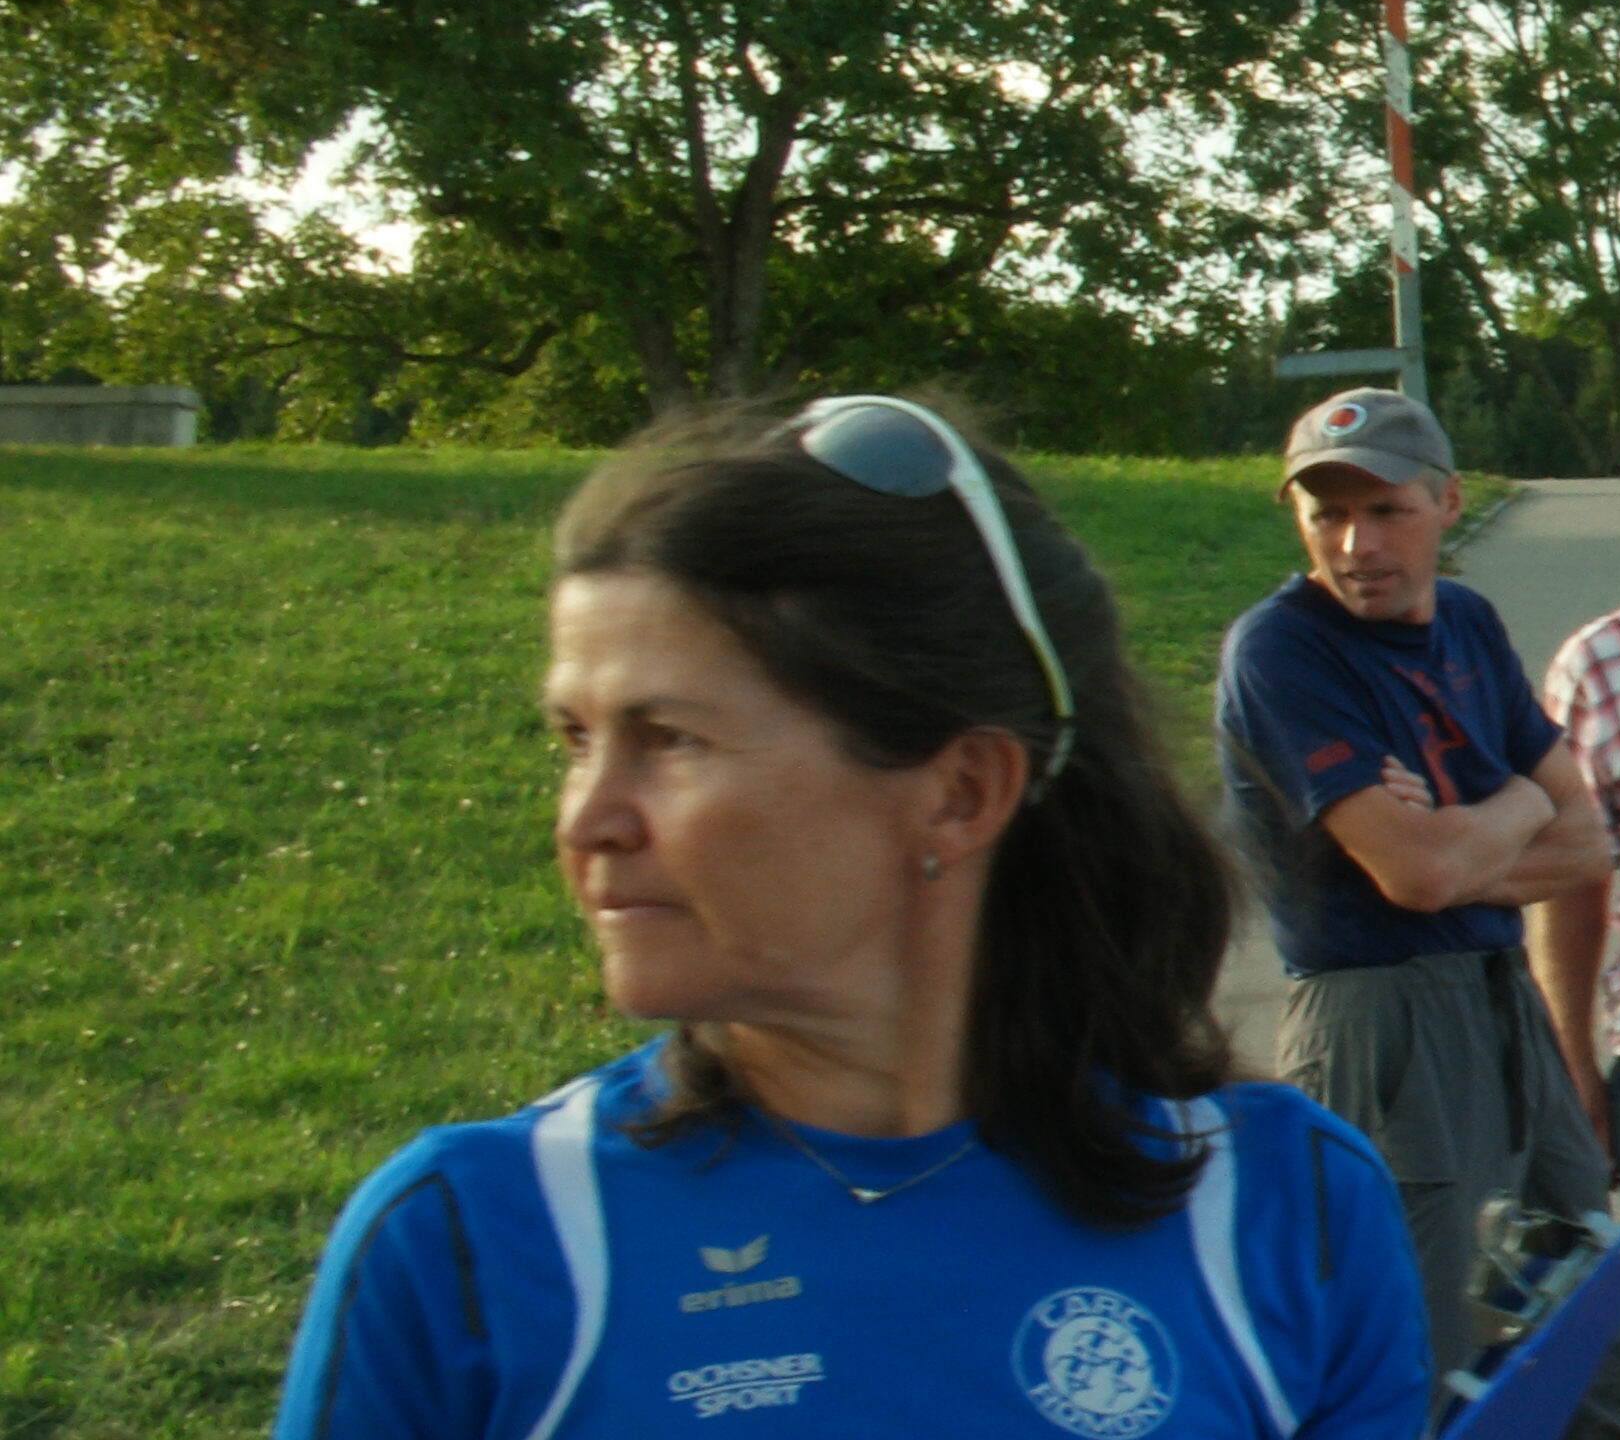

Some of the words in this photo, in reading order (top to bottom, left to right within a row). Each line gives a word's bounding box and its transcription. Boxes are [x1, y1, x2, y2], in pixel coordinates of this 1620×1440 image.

[679, 1276, 803, 1313] erima
[667, 1352, 825, 1393] OCHSNER
[693, 1385, 801, 1419] SPORT
